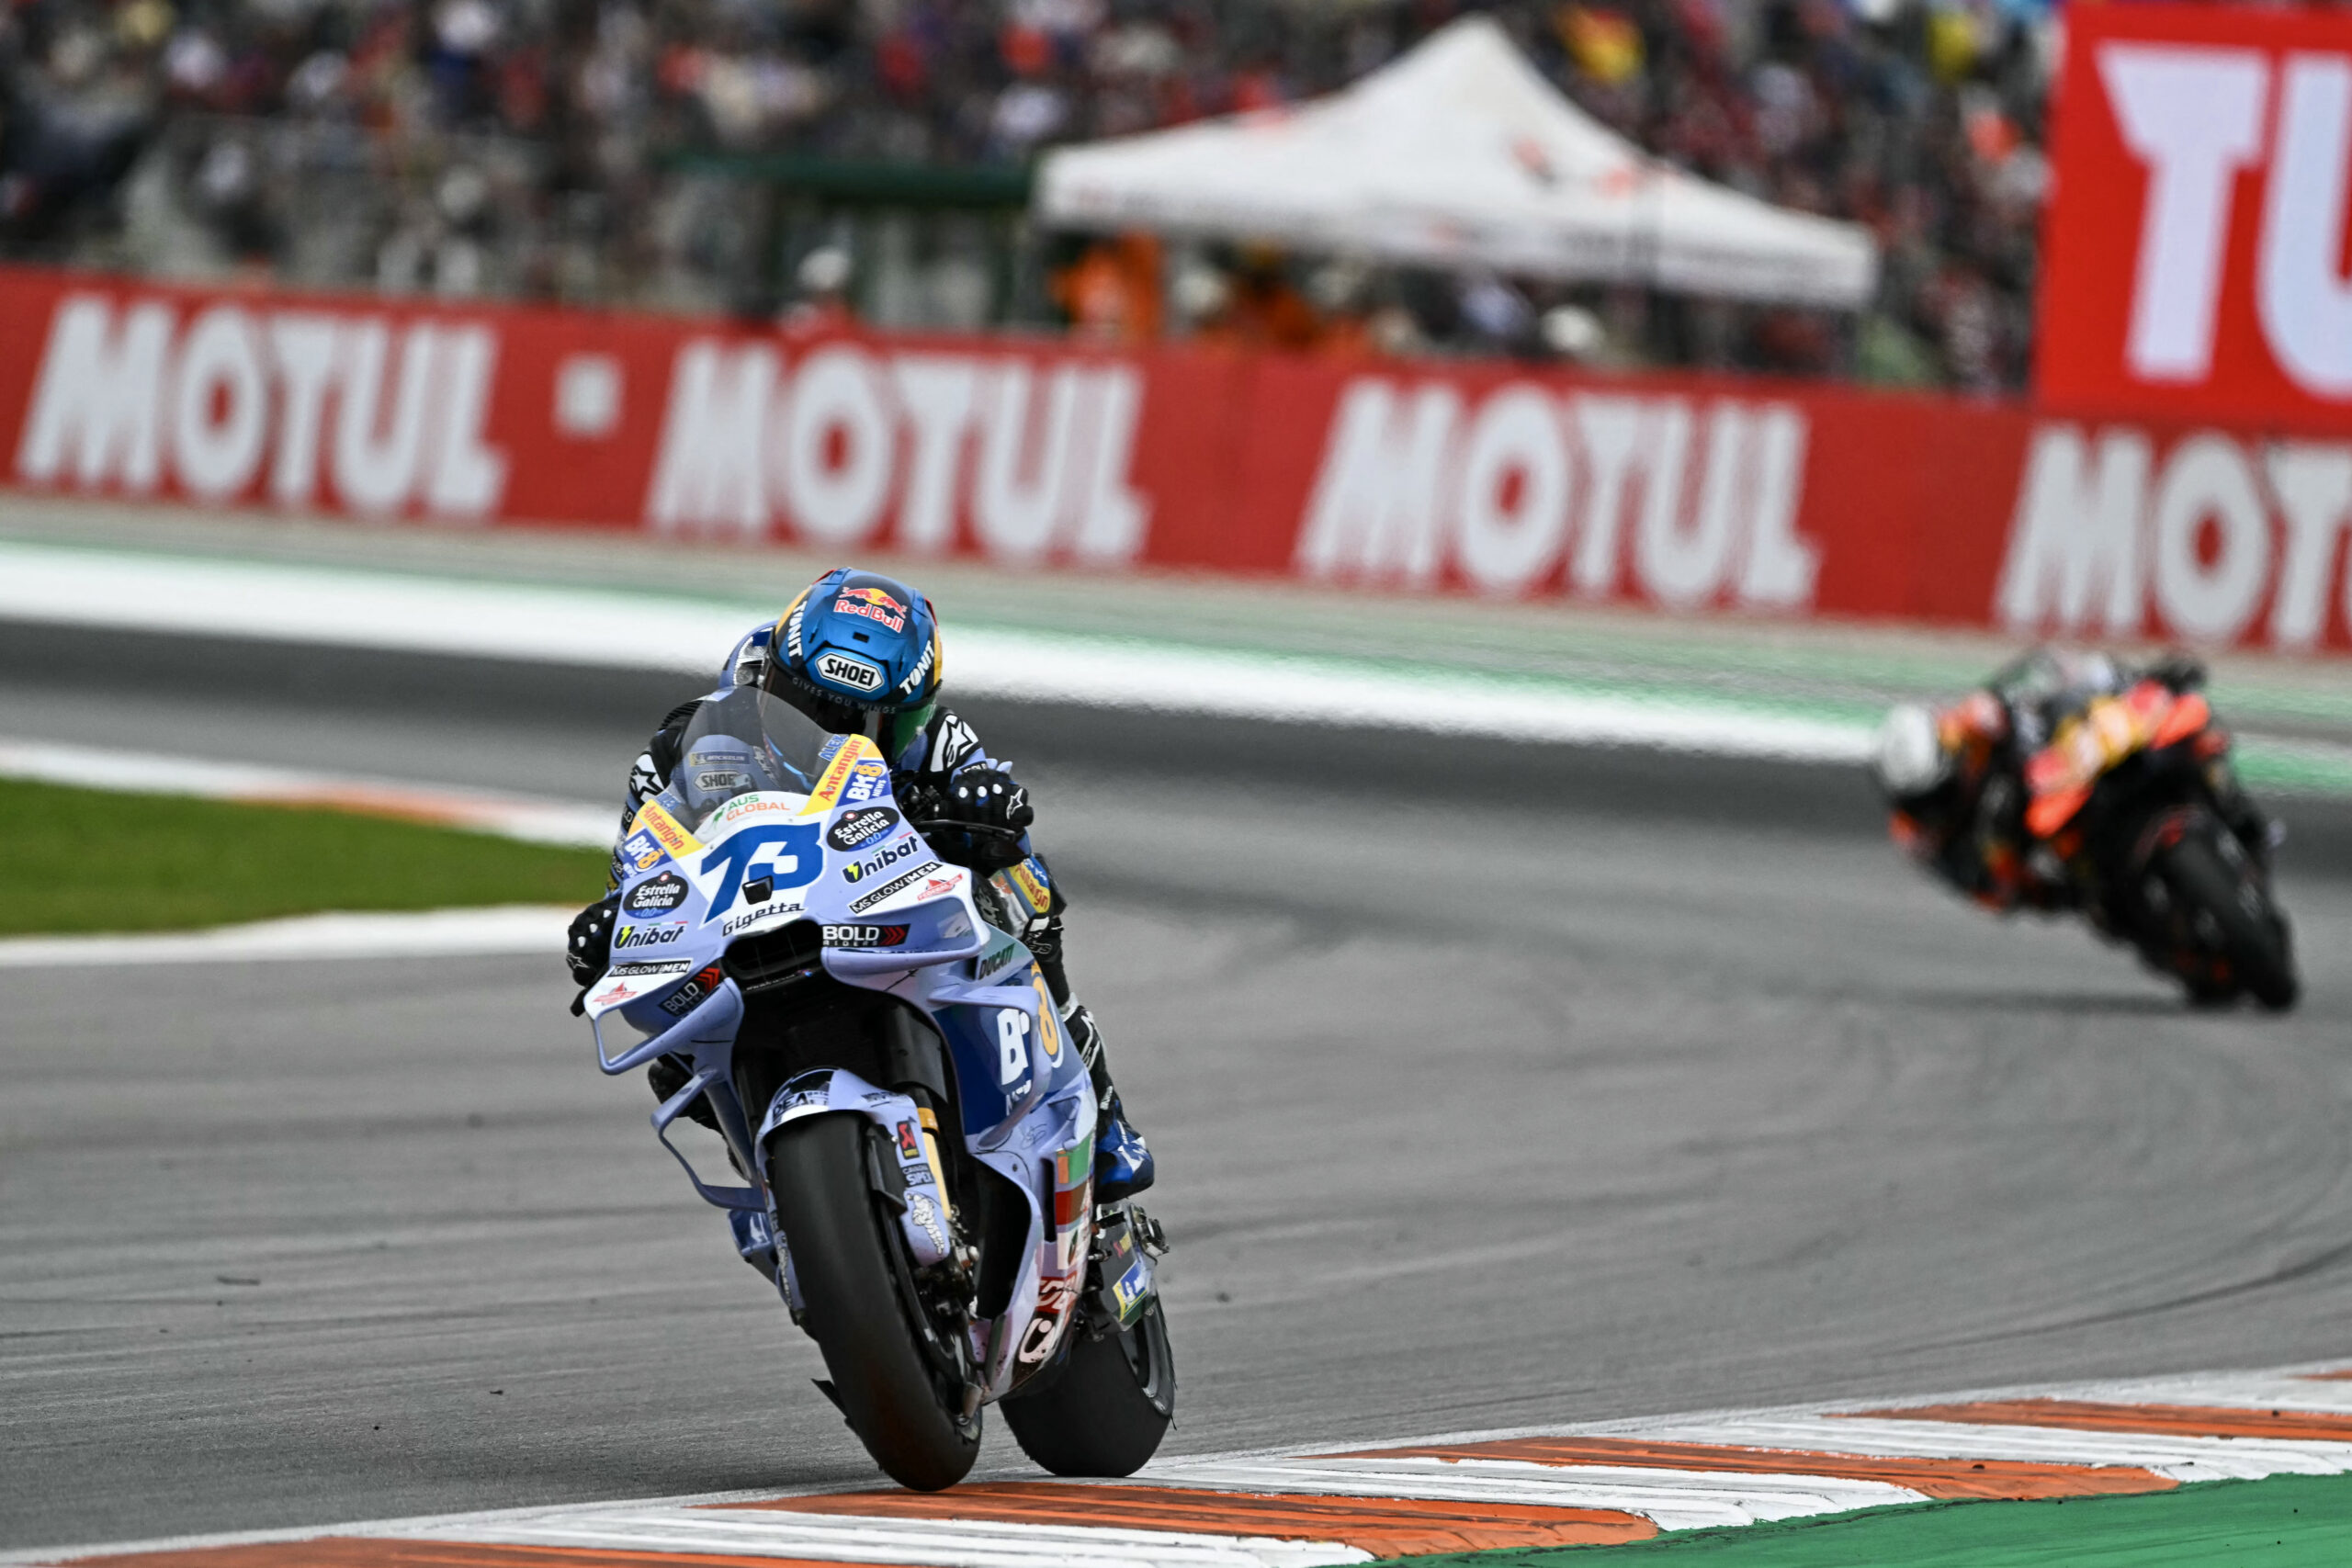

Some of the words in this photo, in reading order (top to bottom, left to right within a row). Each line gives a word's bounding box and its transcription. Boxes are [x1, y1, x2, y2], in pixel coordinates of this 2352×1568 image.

[17, 294, 508, 516] MOTUL
[649, 340, 1150, 562] MOTUL
[1297, 378, 1821, 603] MOTUL
[1994, 421, 2352, 649] MOT
[833, 600, 872, 617] Red
[871, 606, 904, 633] Bull
[825, 659, 876, 686] SHOEI
[792, 678, 822, 697] GIVES
[828, 694, 852, 706] YOU
[857, 702, 897, 715] WINGS
[818, 735, 848, 761] ALEX
[701, 772, 736, 788] SHOE
[819, 739, 863, 801] Antangin
[846, 764, 883, 801] BK8
[728, 795, 759, 811] AUS
[872, 779, 887, 797] NEWS
[726, 802, 790, 821] GLOBAL
[834, 811, 884, 839] Estrella
[643, 807, 684, 851] Antangin
[843, 819, 889, 845] Galicia
[625, 835, 665, 870] BK8
[842, 835, 919, 884] Unibat
[700, 822, 823, 923] 73
[633, 895, 673, 908] Galicia
[636, 884, 681, 897] Estrella
[853, 897, 871, 913] MS
[869, 881, 904, 905] GLOW
[722, 901, 804, 937] Gigetta
[822, 926, 879, 941] BOLD
[614, 926, 684, 949] Unibat
[626, 964, 658, 975] GLOW
[978, 942, 1016, 980] DUCATI
[663, 982, 699, 1011] BOLD
